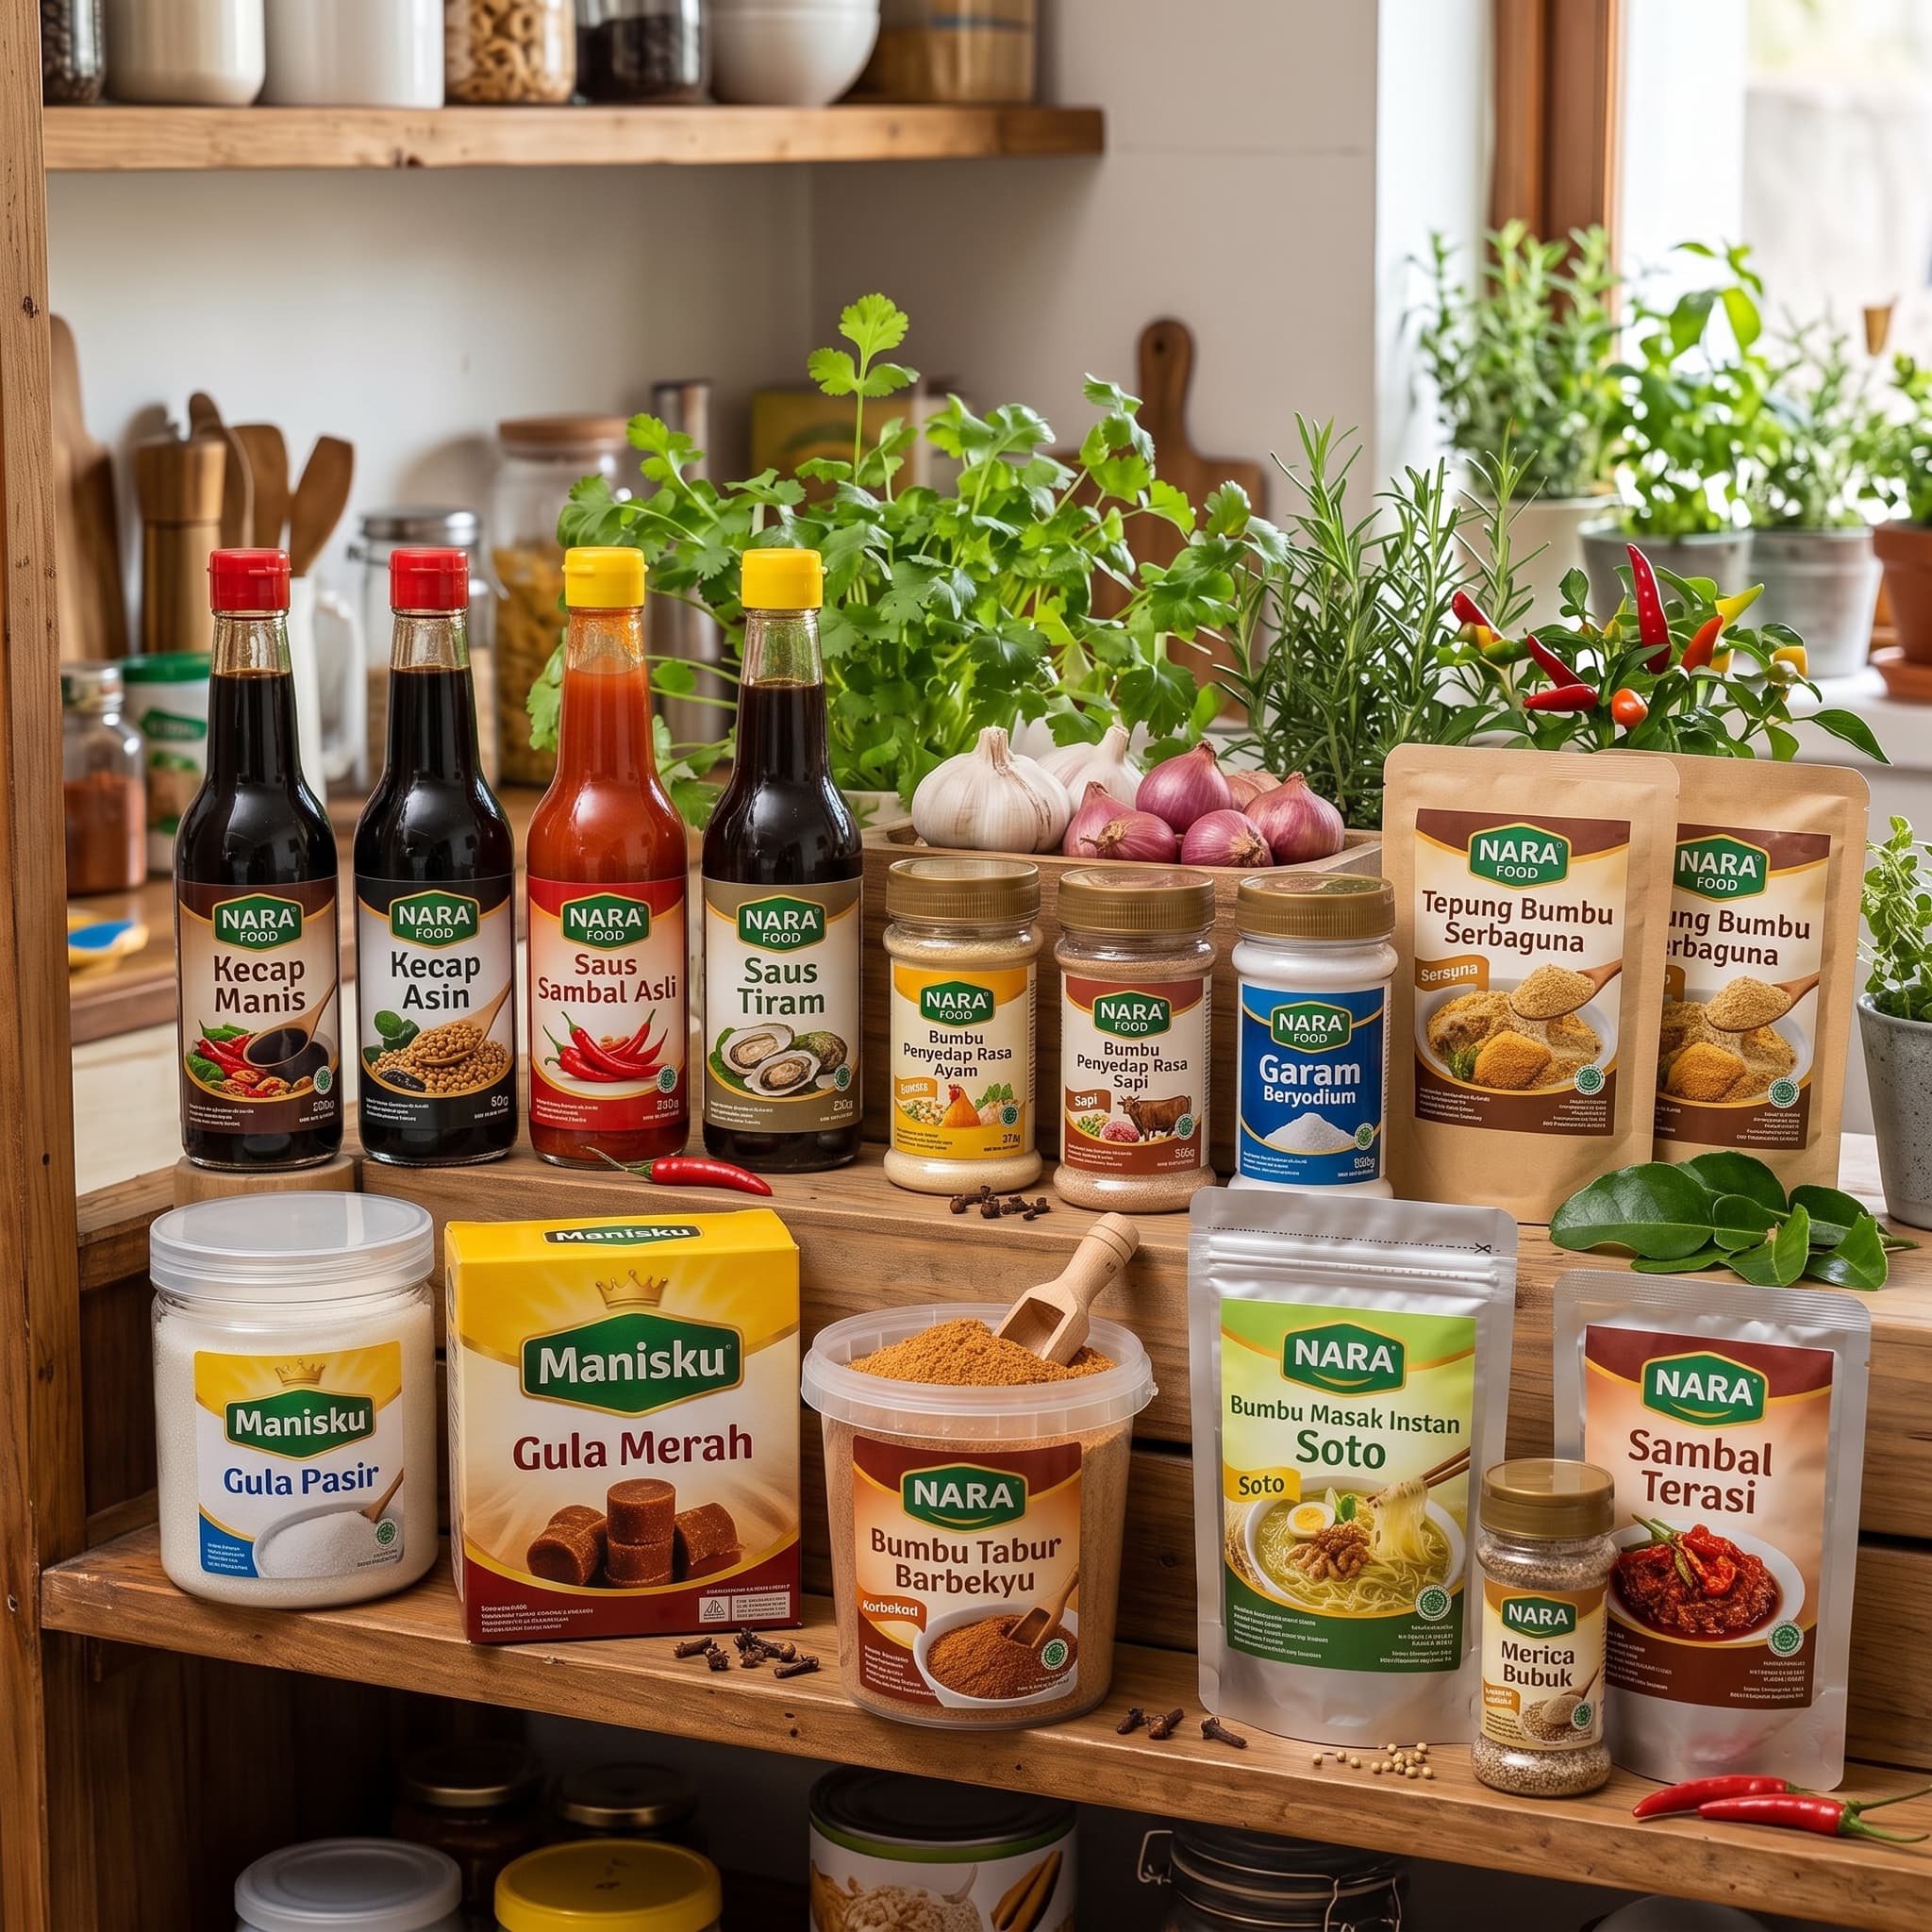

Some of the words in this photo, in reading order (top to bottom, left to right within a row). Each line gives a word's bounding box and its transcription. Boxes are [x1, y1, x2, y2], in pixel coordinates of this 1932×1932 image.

[1479, 840, 1558, 864] NARA
[1496, 866, 1538, 879] FOOD
[1679, 850, 1757, 878] NARA
[1697, 877, 1738, 891] FOOD
[223, 907, 294, 929] NARA
[399, 905, 471, 926] NARA
[570, 908, 641, 927] NARA
[1423, 891, 1511, 923] Tepung
[1521, 898, 1613, 924] Bumbu
[745, 909, 817, 930] NARA
[1719, 909, 1809, 940] Bumbu
[240, 931, 277, 941] FOOD
[415, 928, 453, 938] FOOD
[587, 930, 625, 941] FOOD
[762, 933, 800, 943] FOOD
[1444, 923, 1584, 955] Serbaguna
[214, 956, 305, 987] Kecap
[391, 951, 480, 983] Kecap
[575, 954, 636, 974] Saus
[744, 958, 817, 983] Saus
[215, 987, 306, 1013] Manis
[403, 983, 470, 1010] Asin
[539, 977, 626, 1004] Sambal
[634, 975, 675, 1002] Asli
[926, 991, 987, 1009] NARA
[738, 989, 824, 1014] Tiram
[1101, 1003, 1163, 1020] NARA
[940, 1011, 972, 1020] FOOD
[1115, 1022, 1148, 1031] FOOD
[1279, 1013, 1342, 1032] NARA
[929, 1030, 983, 1044] Bumbu
[1294, 1034, 1326, 1043] FOOD
[904, 1043, 974, 1060] Penyedap
[977, 1047, 1012, 1060] Rasa
[1104, 1042, 1159, 1057] Bumbu
[934, 1064, 977, 1079] Ayam
[1077, 1055, 1148, 1074] Penyedap
[1154, 1059, 1188, 1072] Rasa
[1259, 1055, 1360, 1085] Garam
[1113, 1075, 1149, 1091] Sapi
[1074, 1095, 1097, 1108] Sapi
[1264, 1085, 1356, 1108] Beryodium
[557, 1226, 690, 1241] Manisku
[539, 1340, 724, 1384] Manisku
[1295, 1339, 1394, 1374] NARA
[1656, 1370, 1753, 1406] NARA
[236, 1407, 366, 1436] Manisku
[1230, 1395, 1304, 1423] Bumbu
[1310, 1404, 1383, 1430] Masak
[1390, 1411, 1460, 1434] Instan
[513, 1432, 607, 1472] Gula
[620, 1424, 753, 1466] Merah
[1296, 1430, 1386, 1470] Soto
[1628, 1429, 1772, 1477] Sambal
[225, 1468, 292, 1495] Gula
[302, 1462, 379, 1494] Pasir
[1239, 1474, 1284, 1497] Soto
[914, 1479, 1013, 1509] NARA
[1641, 1470, 1756, 1515] Terasi
[872, 1528, 968, 1564] Bumbu
[976, 1538, 1061, 1564] Tabur
[896, 1564, 1034, 1598] Barbekyu
[1509, 1604, 1568, 1624] NARA
[1502, 1641, 1574, 1664] Merica
[1504, 1664, 1573, 1687] Bubuk
